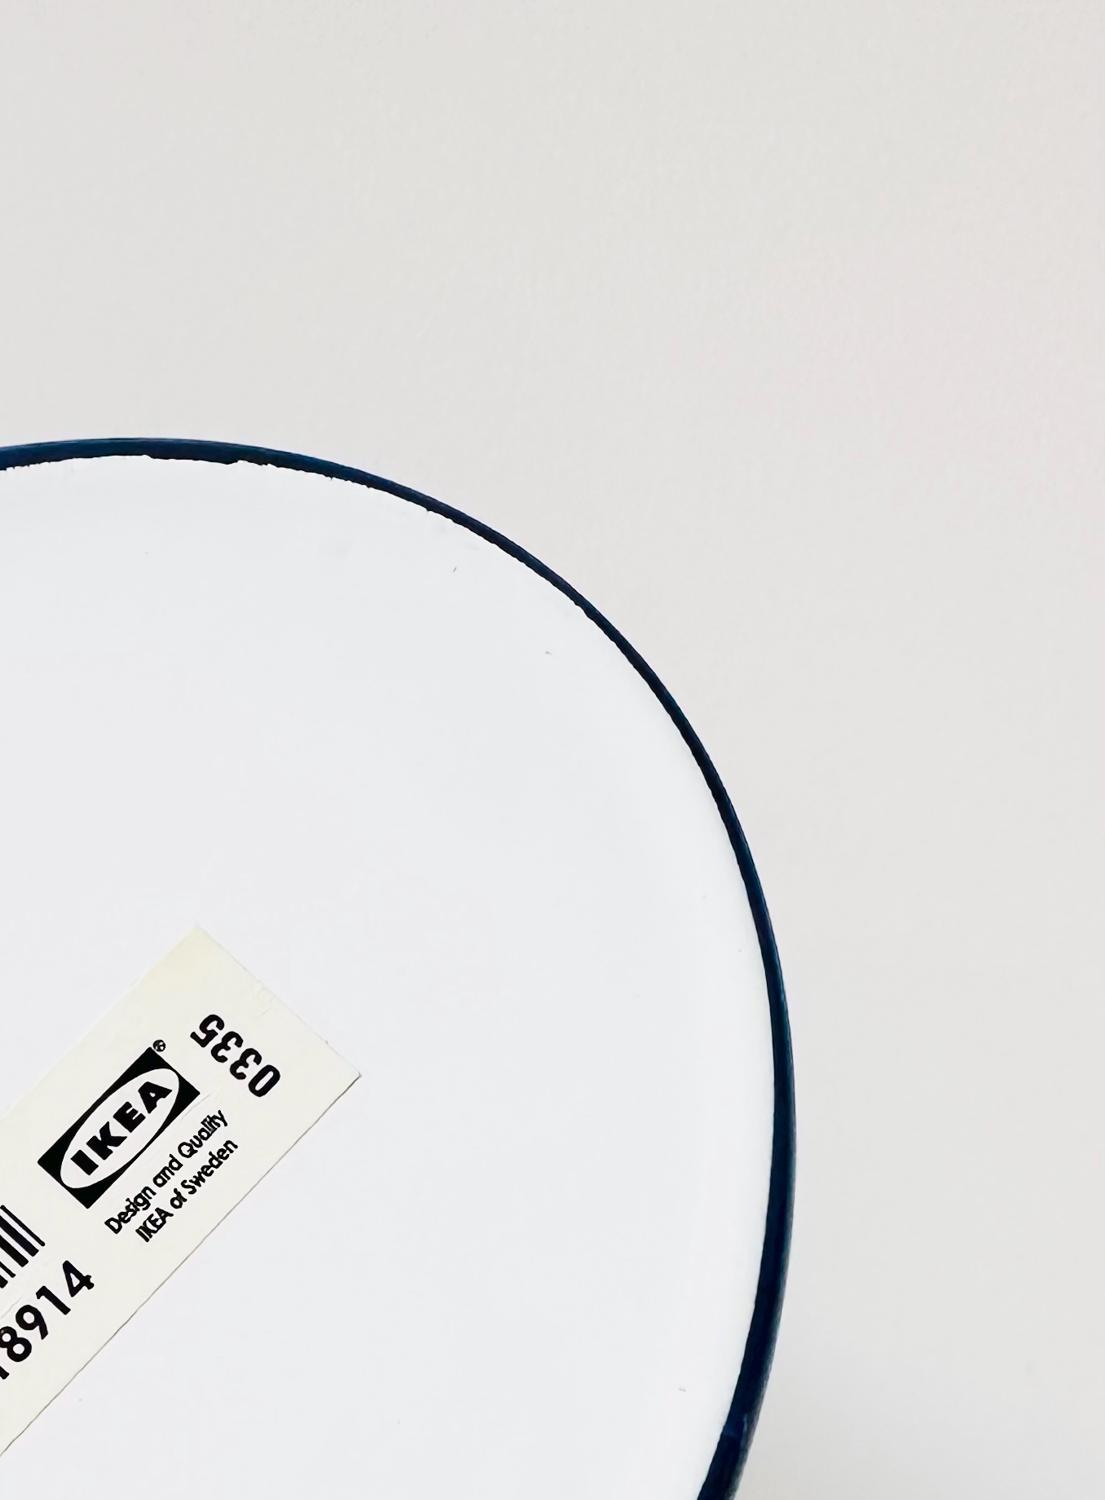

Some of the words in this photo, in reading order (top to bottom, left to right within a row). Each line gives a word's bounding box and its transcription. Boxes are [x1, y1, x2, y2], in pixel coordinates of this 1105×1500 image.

[190, 1014, 281, 1098] 0335
[70, 1081, 173, 1176] IKEA
[104, 1185, 156, 1235] Design
[152, 1153, 184, 1188] and
[177, 1109, 228, 1159] Quality
[135, 1206, 174, 1243] IKEA
[169, 1187, 188, 1210] of
[180, 1139, 239, 1195] Sweden
